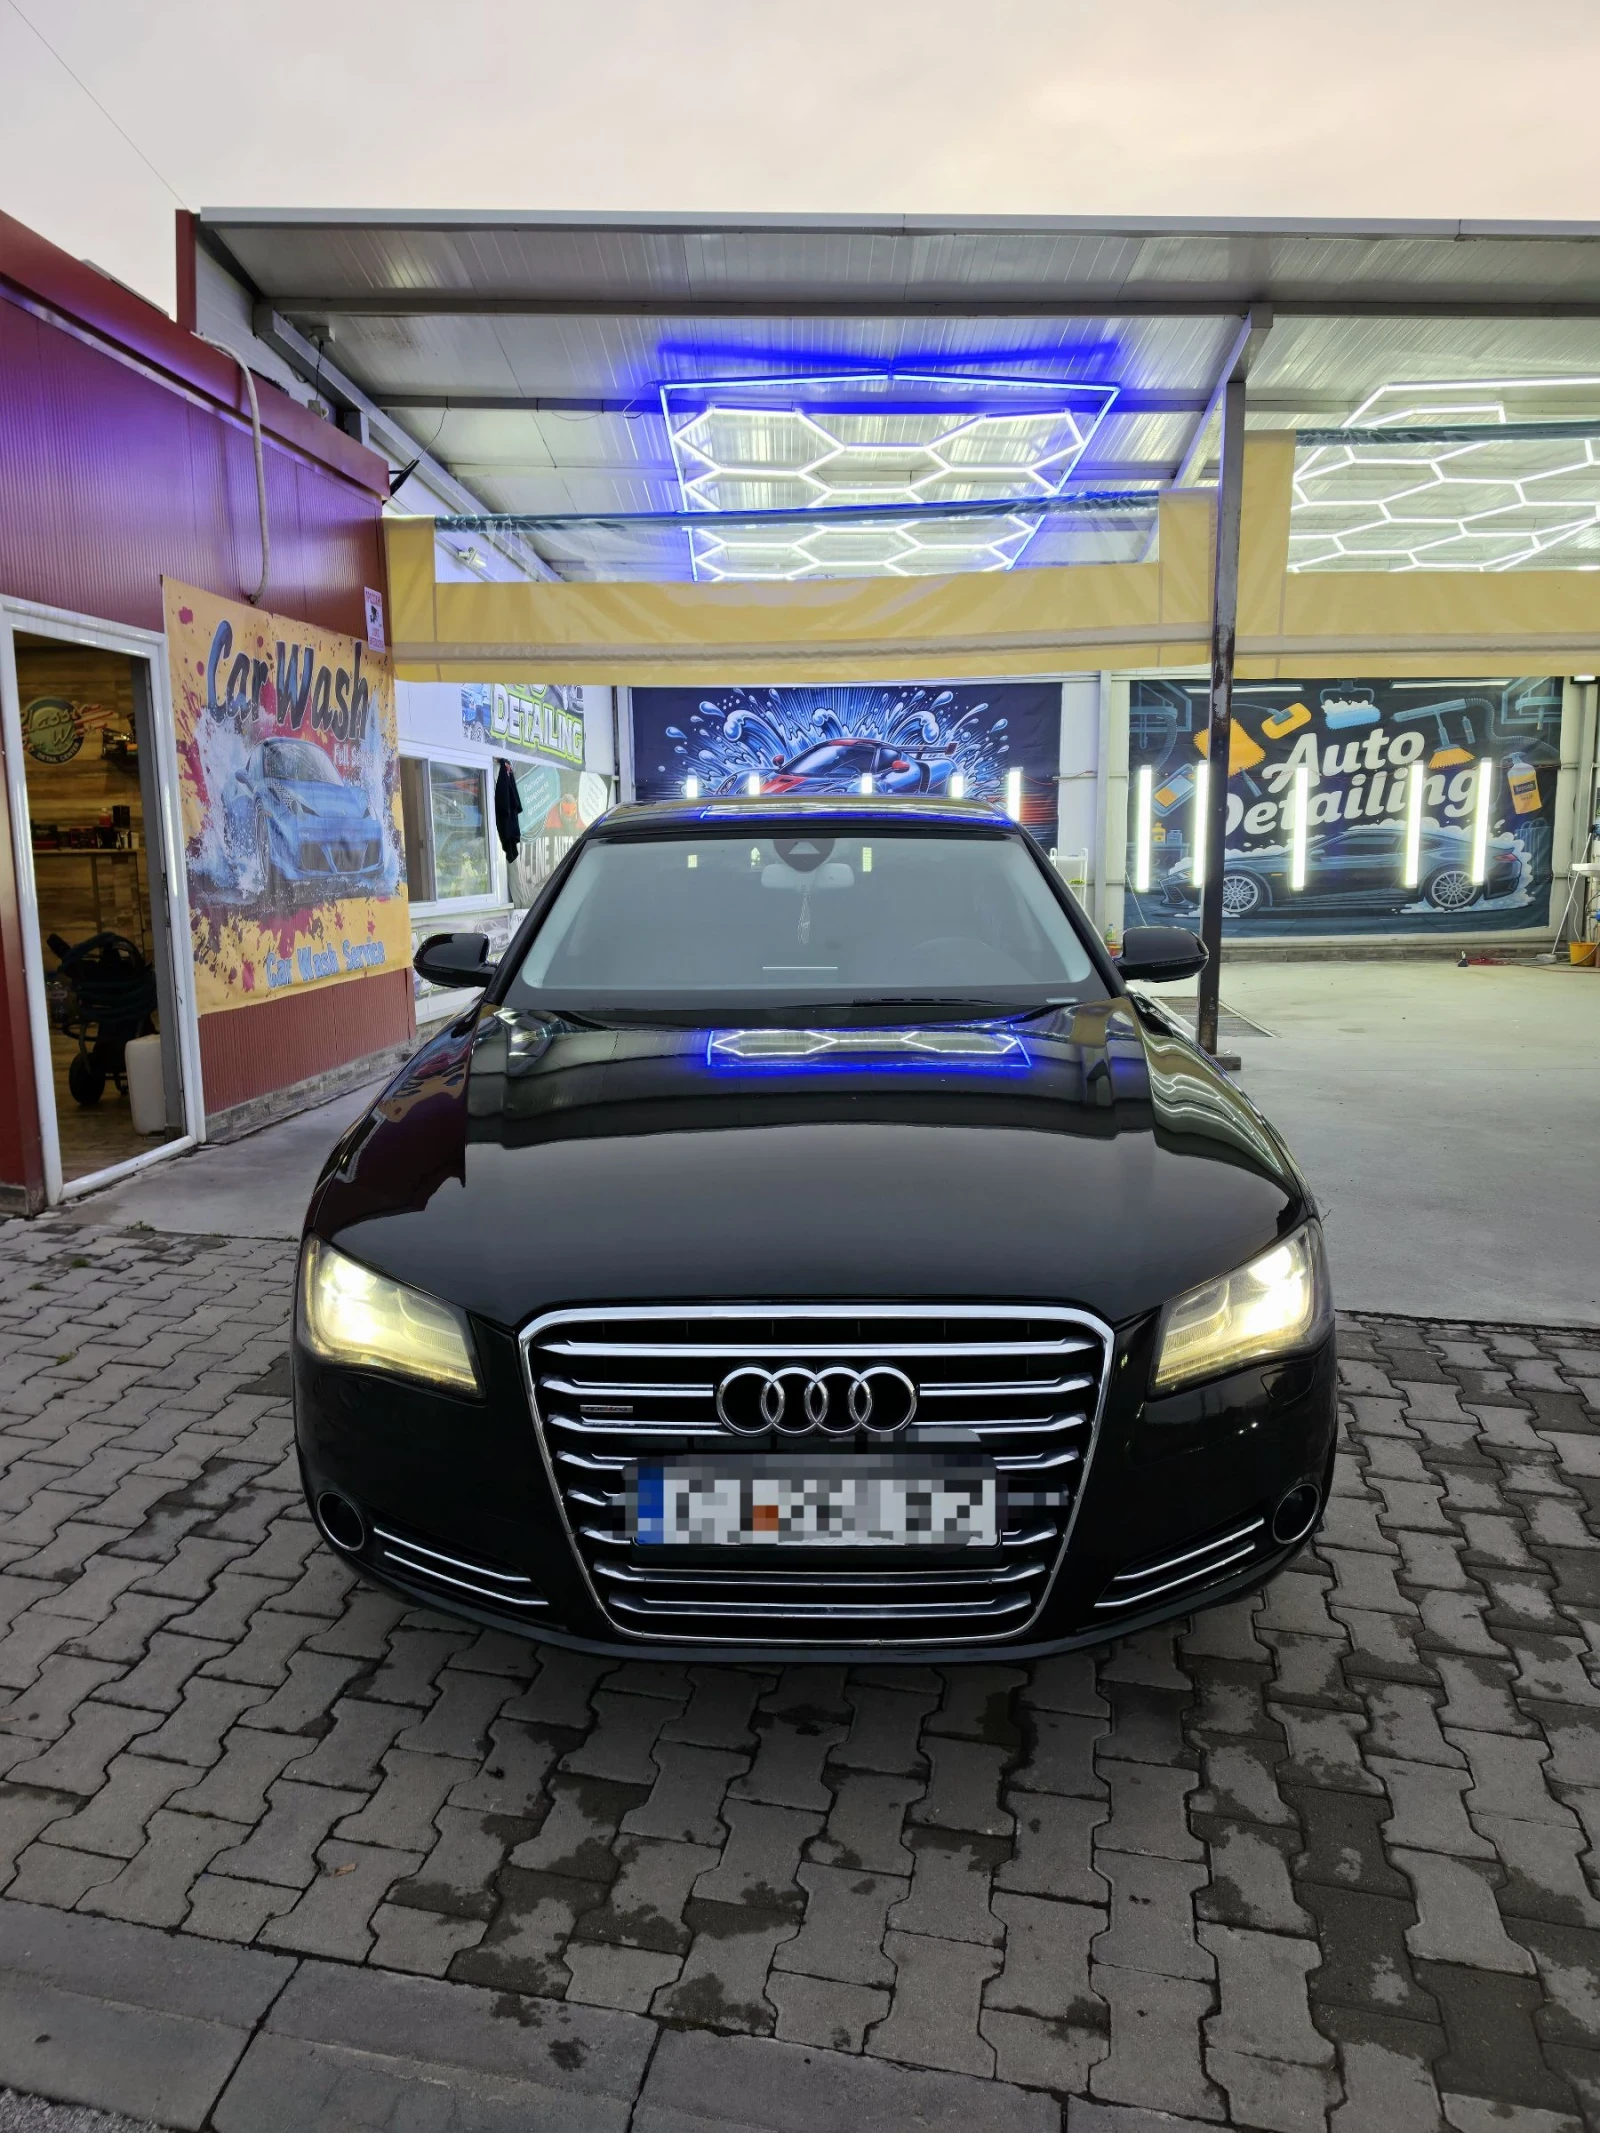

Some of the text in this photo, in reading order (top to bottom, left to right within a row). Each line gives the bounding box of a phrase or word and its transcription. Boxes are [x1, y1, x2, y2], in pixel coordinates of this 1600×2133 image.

[207, 620, 369, 741] Car Wash
[490, 683, 583, 763] DETAILING
[1261, 728, 1425, 794] Auto
[266, 952, 293, 988] Car
[297, 943, 339, 981] Wash
[342, 936, 386, 971] Service
